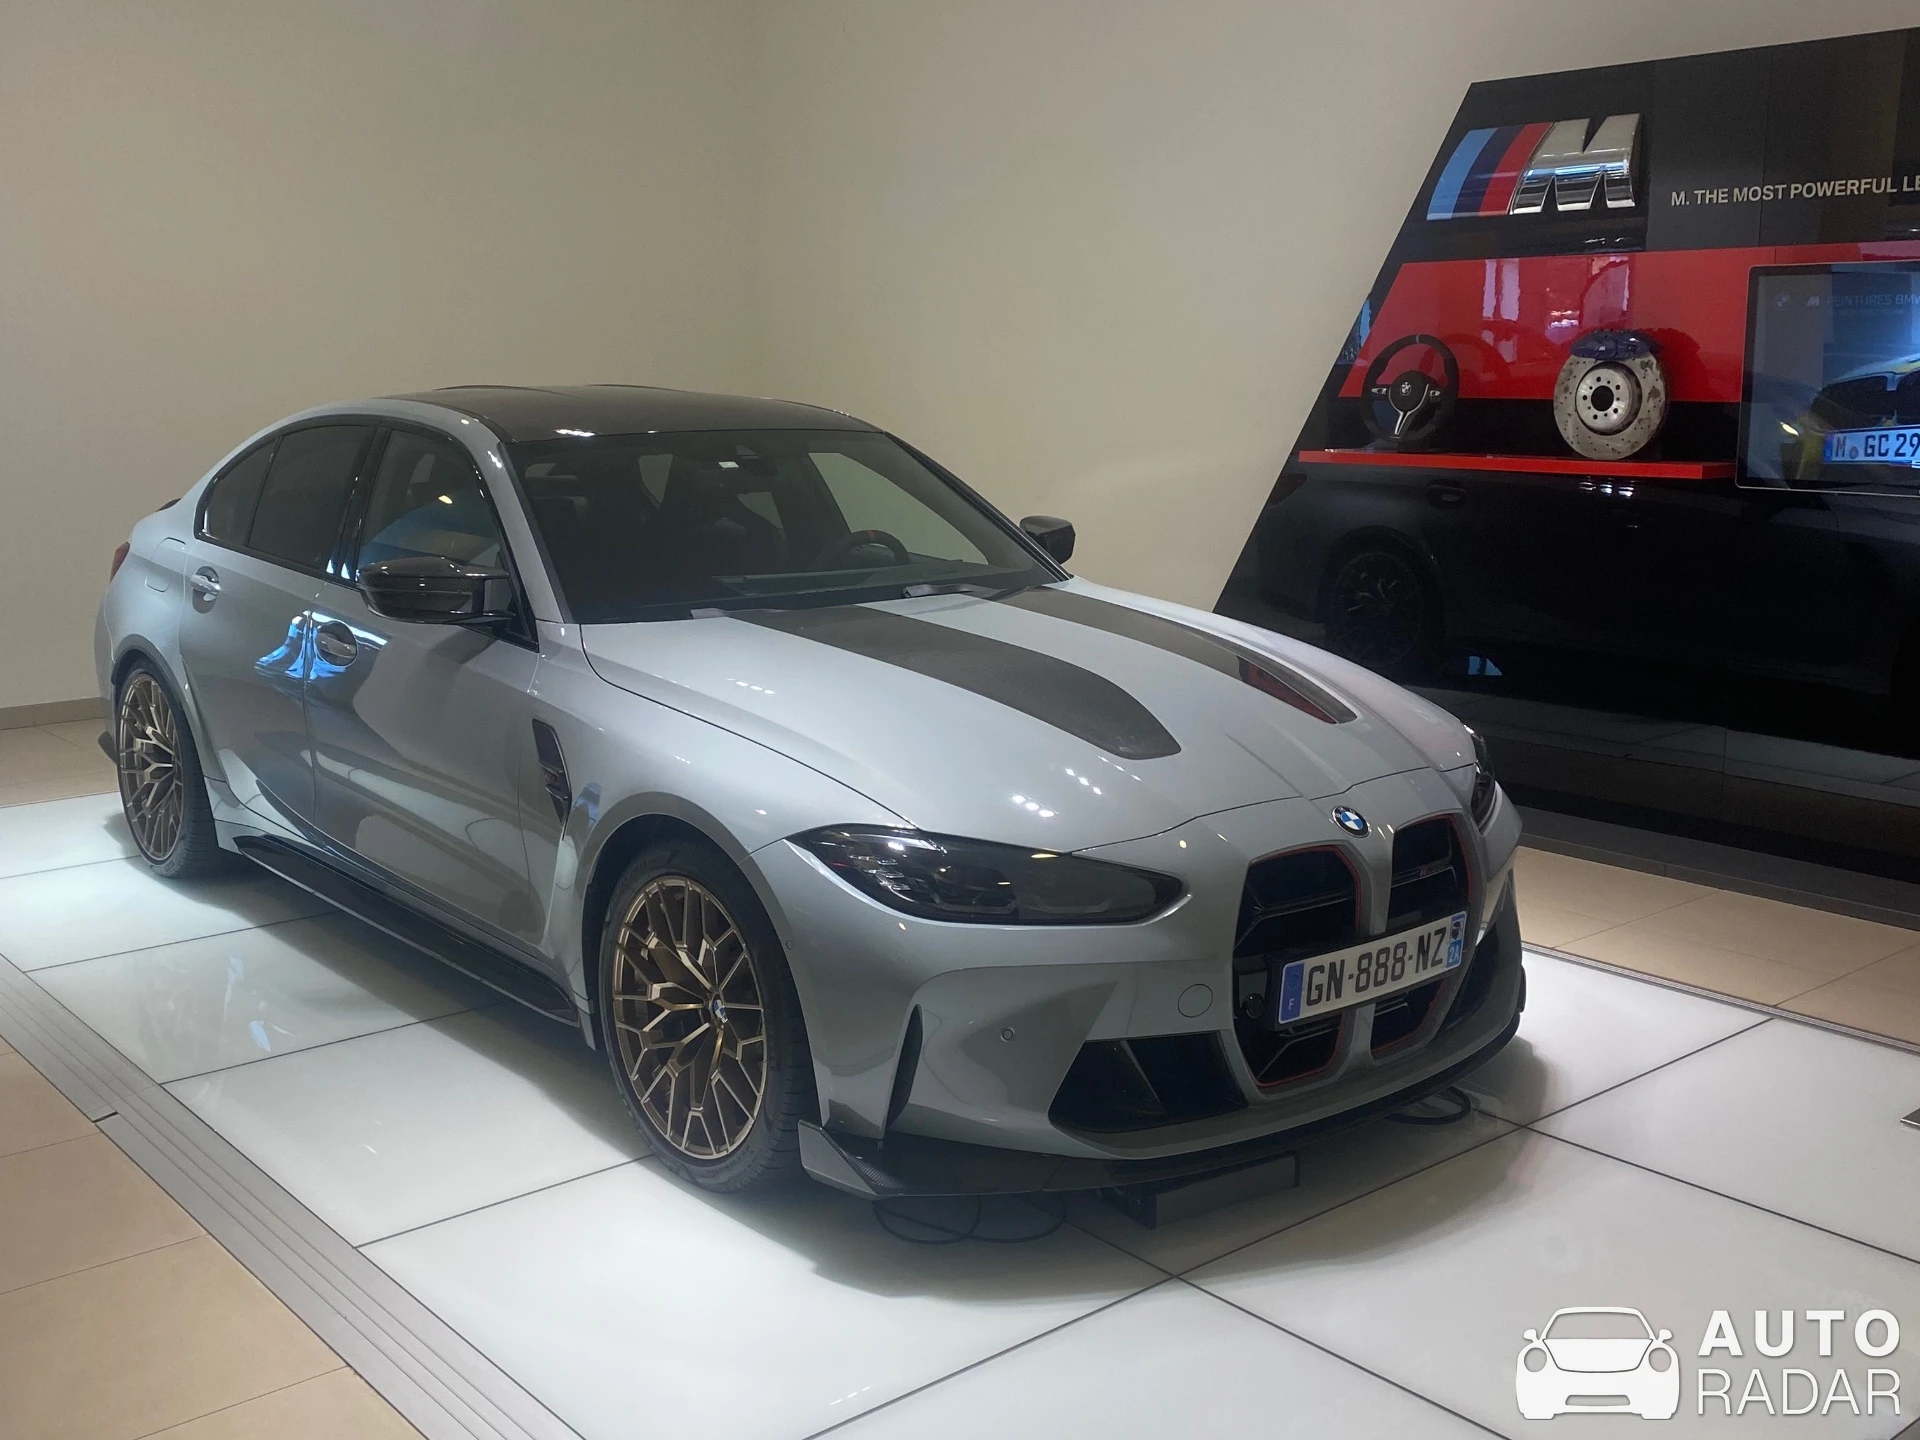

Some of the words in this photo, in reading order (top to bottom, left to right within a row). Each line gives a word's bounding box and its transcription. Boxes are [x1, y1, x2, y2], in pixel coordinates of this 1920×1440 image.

[1671, 191, 1690, 207] M.
[1694, 188, 1728, 204] THE
[1733, 184, 1787, 202] MOST
[1790, 176, 1897, 199] POWERFUL
[1864, 433, 1889, 457] GC
[1306, 926, 1447, 1007] GN-888-NZ
